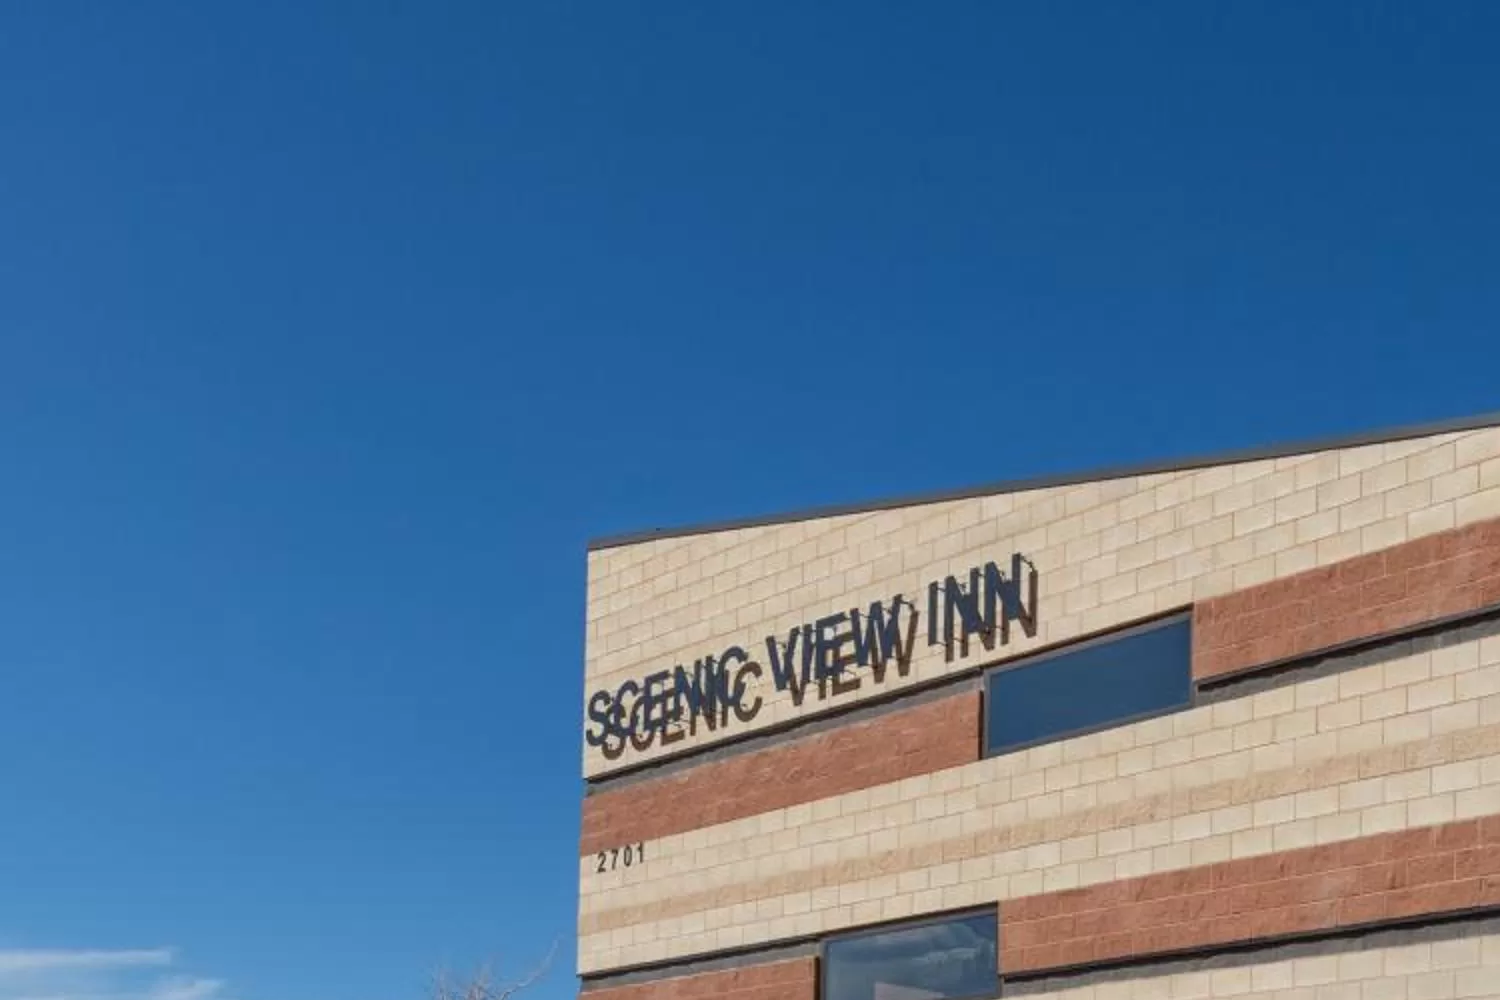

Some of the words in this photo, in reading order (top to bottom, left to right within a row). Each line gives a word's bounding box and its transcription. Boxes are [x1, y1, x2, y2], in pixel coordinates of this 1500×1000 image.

[586, 646, 749, 747] SCENIC
[766, 594, 903, 691] VIEW
[928, 553, 1021, 646] INN
[597, 841, 644, 873] 2701
